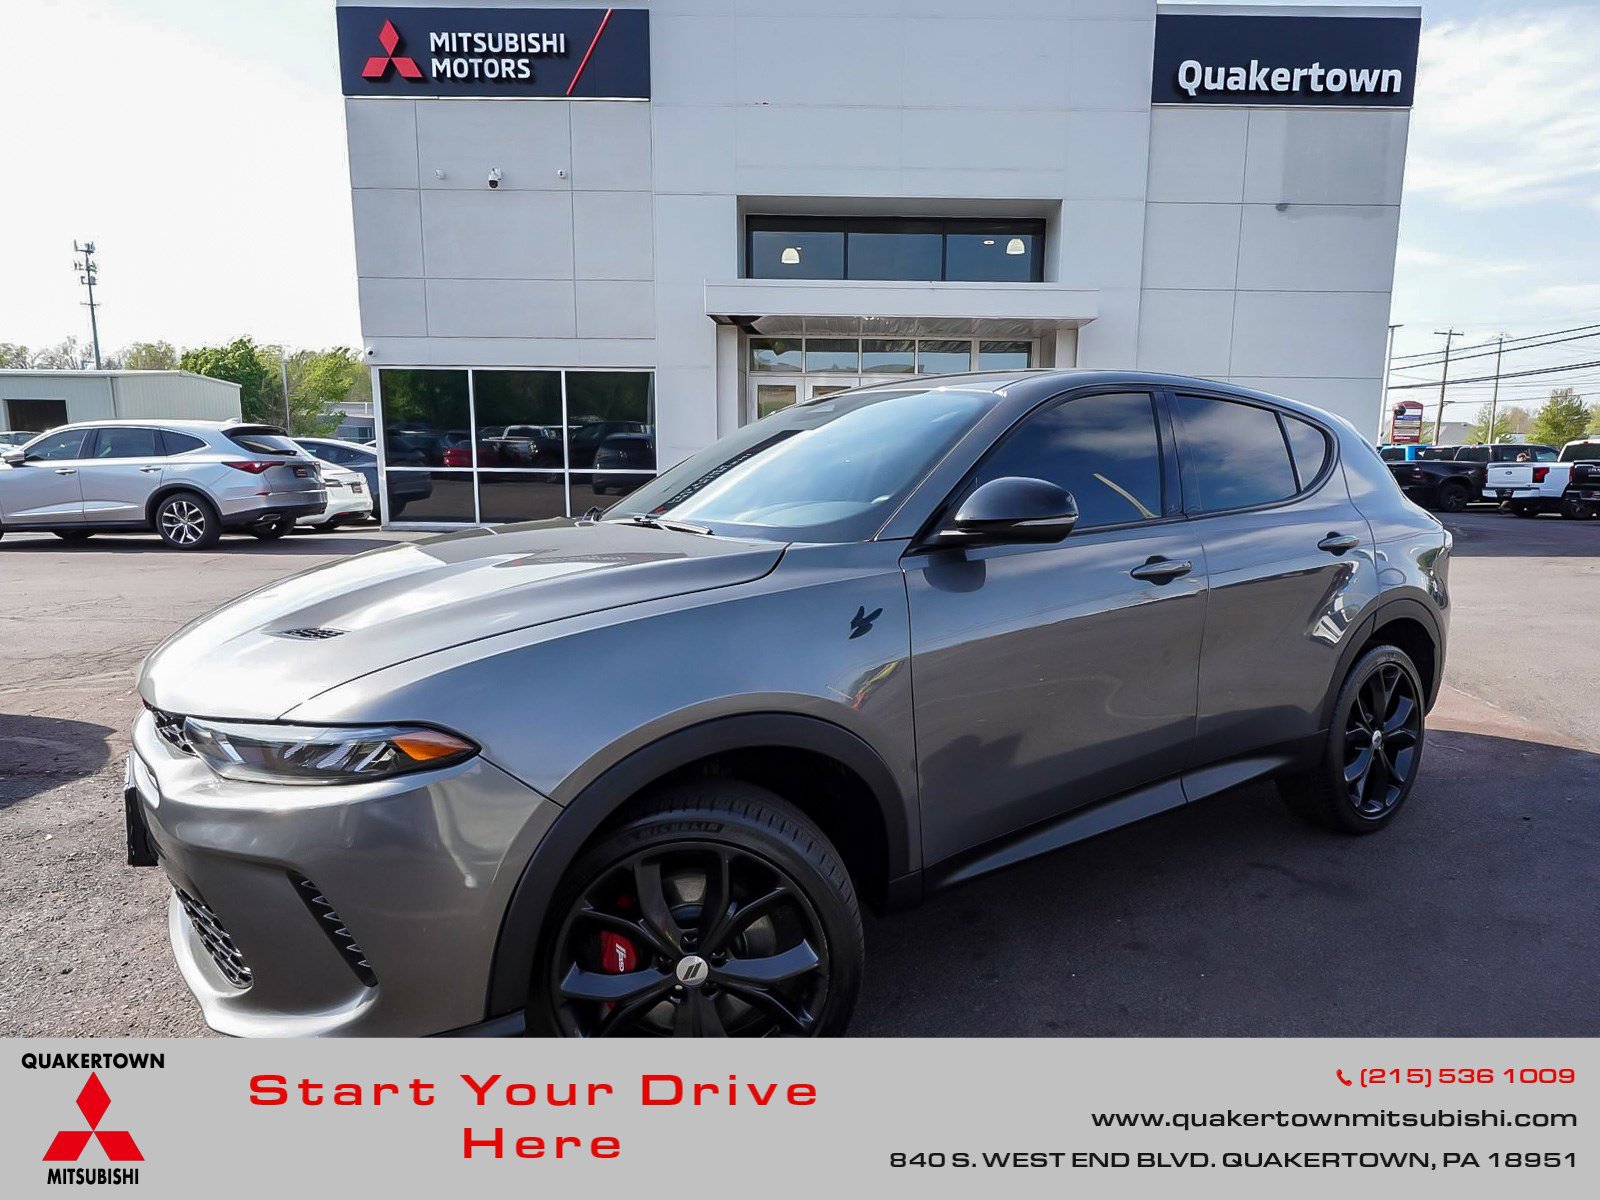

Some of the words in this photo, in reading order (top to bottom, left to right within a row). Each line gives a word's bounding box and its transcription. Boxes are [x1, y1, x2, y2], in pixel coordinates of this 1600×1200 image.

[429, 32, 565, 53] MITSUBISHI
[431, 58, 531, 79] MOTORS
[1178, 59, 1403, 96] Quakertown
